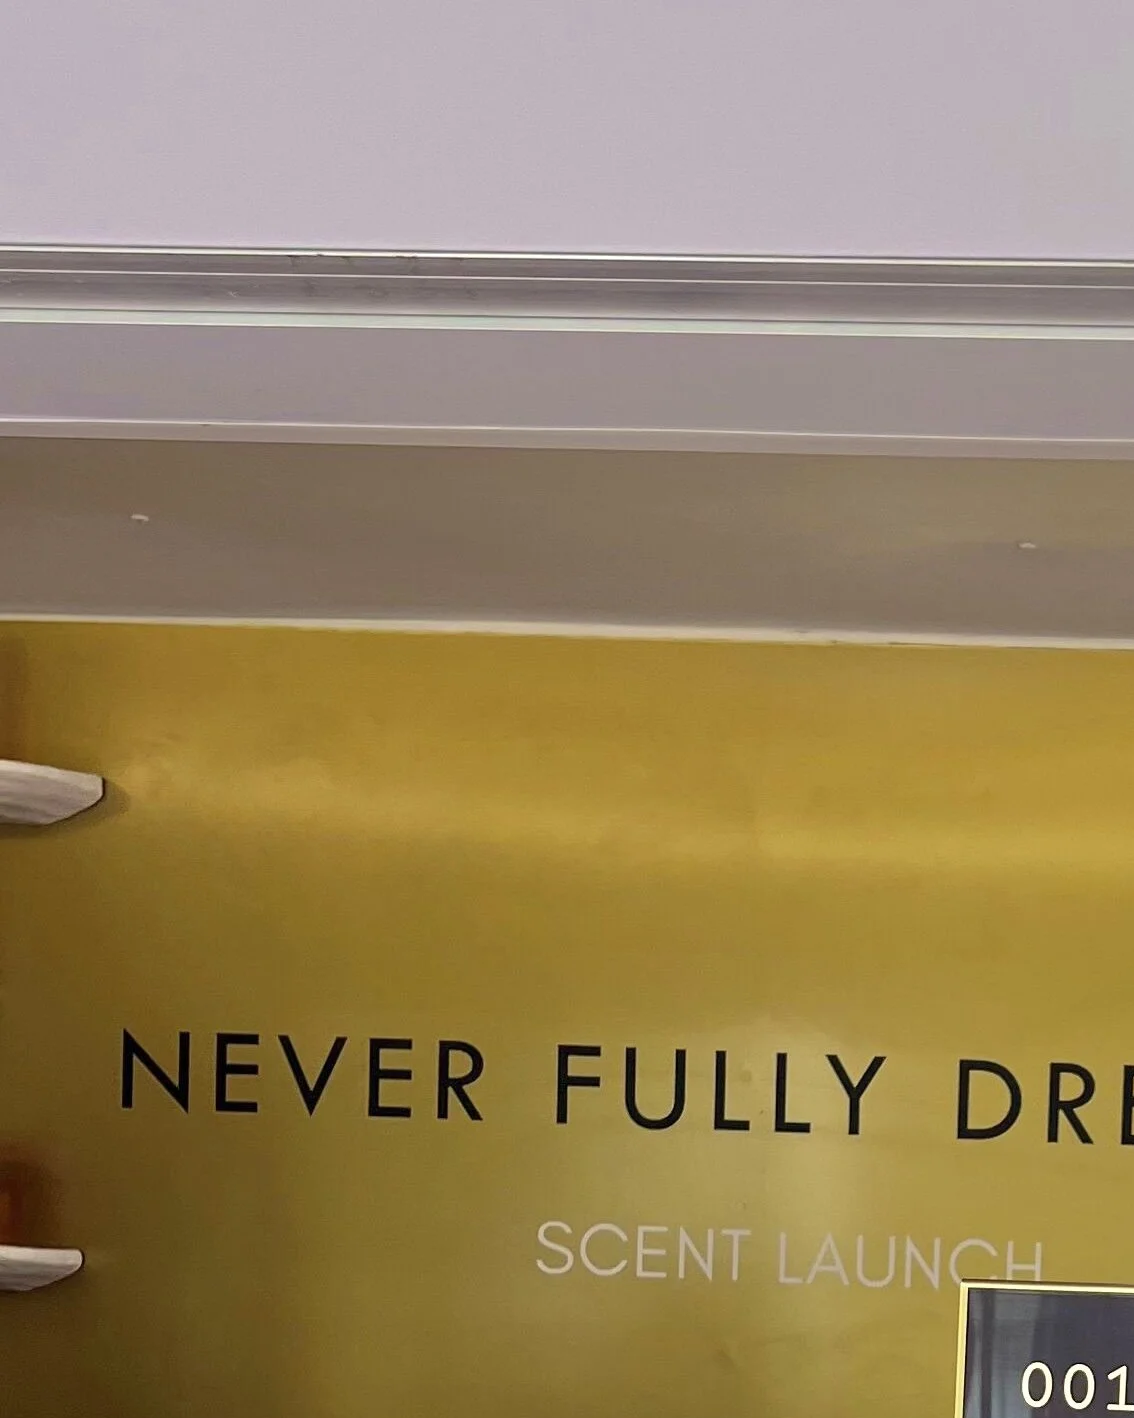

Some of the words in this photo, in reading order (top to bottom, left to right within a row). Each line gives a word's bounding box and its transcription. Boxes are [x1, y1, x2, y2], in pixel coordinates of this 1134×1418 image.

[121, 1028, 485, 1121] NEVER
[555, 1043, 886, 1136] FULLY
[536, 1220, 751, 1281] SCENT
[778, 1231, 1042, 1289] LAUNCH
